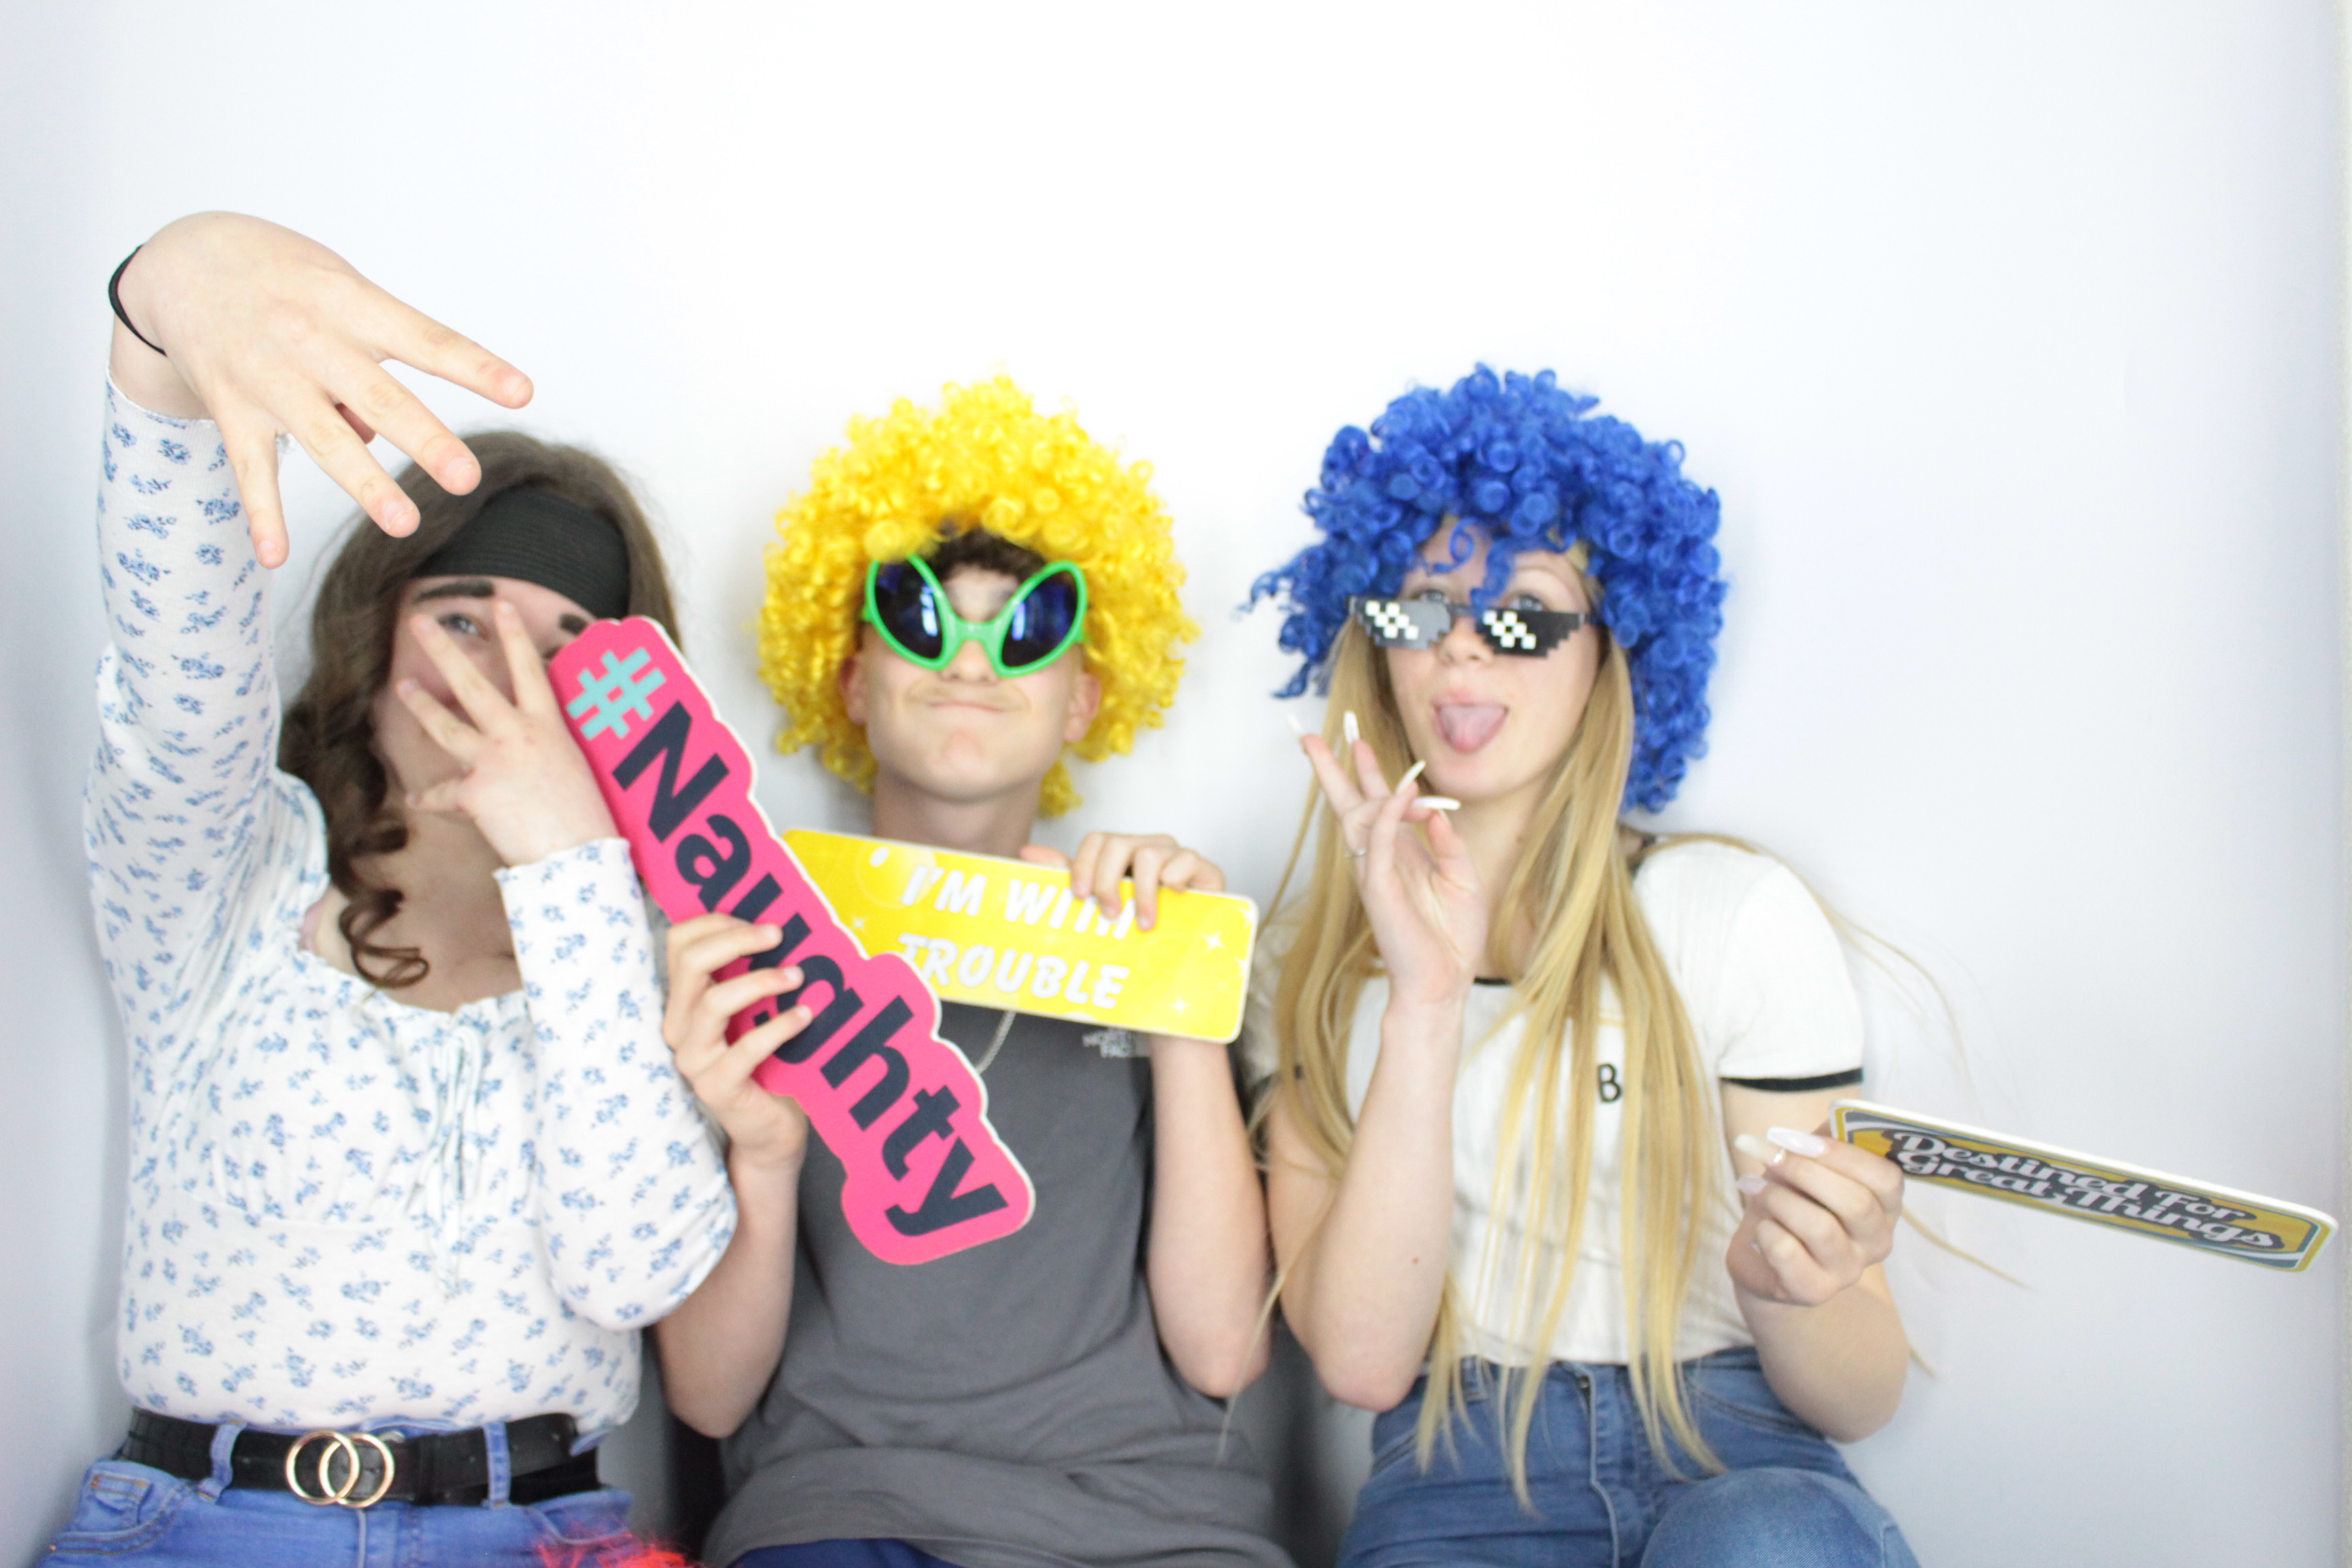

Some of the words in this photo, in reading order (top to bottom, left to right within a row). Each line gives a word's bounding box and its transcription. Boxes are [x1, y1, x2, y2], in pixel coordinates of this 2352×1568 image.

[898, 864, 988, 917] I'M
[565, 646, 1009, 1237] #Naughty
[898, 932, 1130, 1009] TROUBLE
[1597, 1062, 1622, 1103] B
[1893, 1132, 2149, 1200] Destined
[2155, 1191, 2246, 1220] For
[1897, 1150, 2053, 1197] Great
[2063, 1186, 2274, 1247] Things
